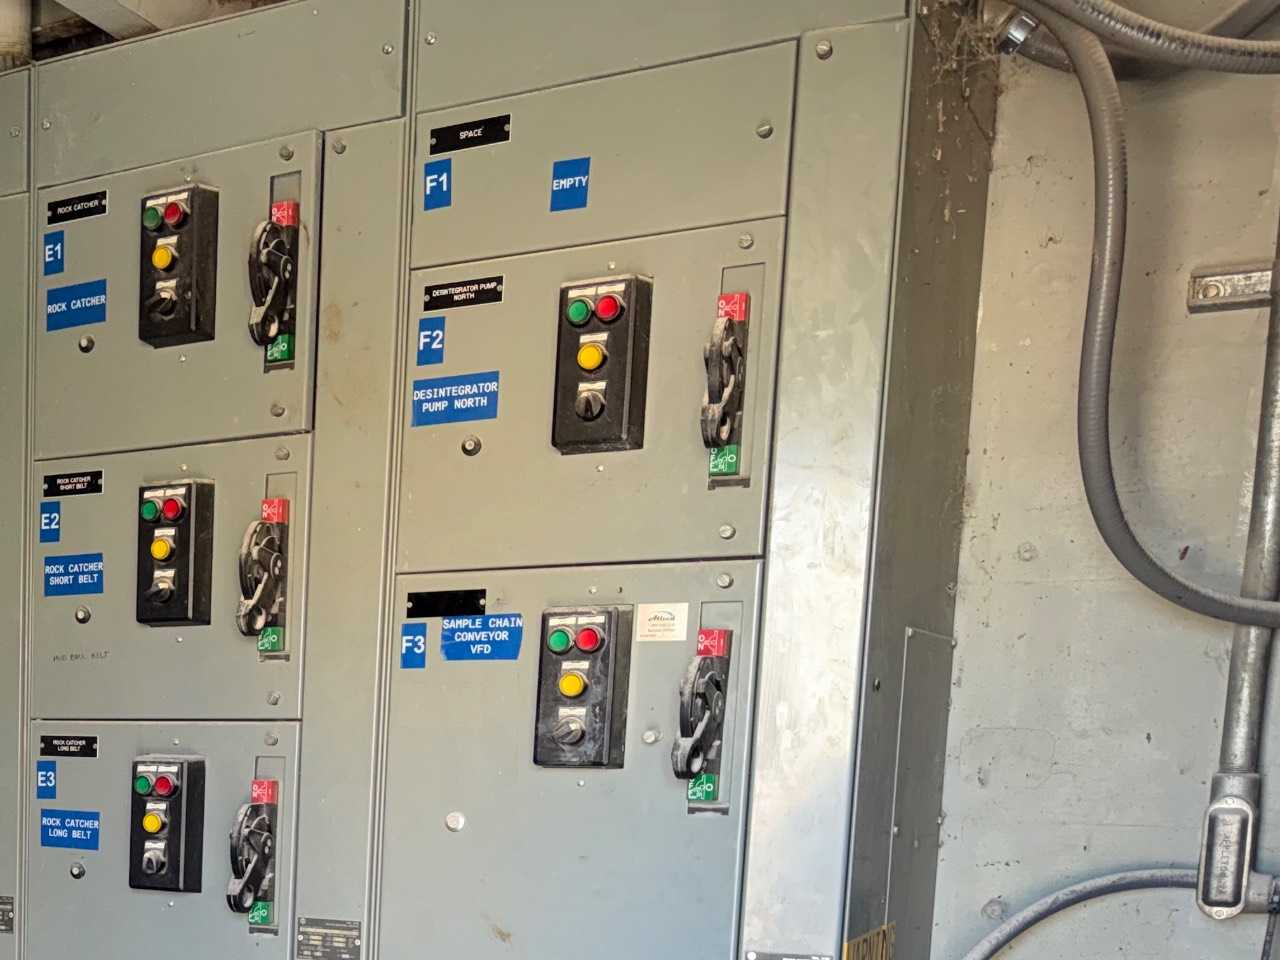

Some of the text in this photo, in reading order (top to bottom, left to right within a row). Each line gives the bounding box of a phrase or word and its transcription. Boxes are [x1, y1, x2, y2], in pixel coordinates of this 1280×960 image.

[459, 128, 482, 139] SPACE
[426, 172, 448, 195] F1
[553, 176, 588, 190] EMPTY
[57, 200, 99, 214] ROCK CATCHER
[45, 243, 62, 262] E1
[432, 281, 497, 298] DESINTEGRATOR PUMP
[453, 293, 475, 301] NORTH
[48, 295, 106, 314] ROCK CATCHER
[420, 330, 444, 350] F2
[413, 382, 498, 401] DESINTEGRATOR
[422, 397, 487, 412] PUMP NORTH
[57, 477, 69, 485] ROCK
[41, 513, 60, 529] E2
[45, 562, 104, 574] ROCK CATCHER
[49, 574, 98, 586] SHORT BELT
[443, 616, 523, 630] SAMPLE CHAIN
[455, 630, 509, 642] CONVEYOR
[402, 635, 425, 654] F3
[470, 643, 491, 655] VFD
[38, 771, 56, 787] E3
[42, 817, 99, 829] ROCK CATCHER
[48, 828, 91, 839] LONG BELT
